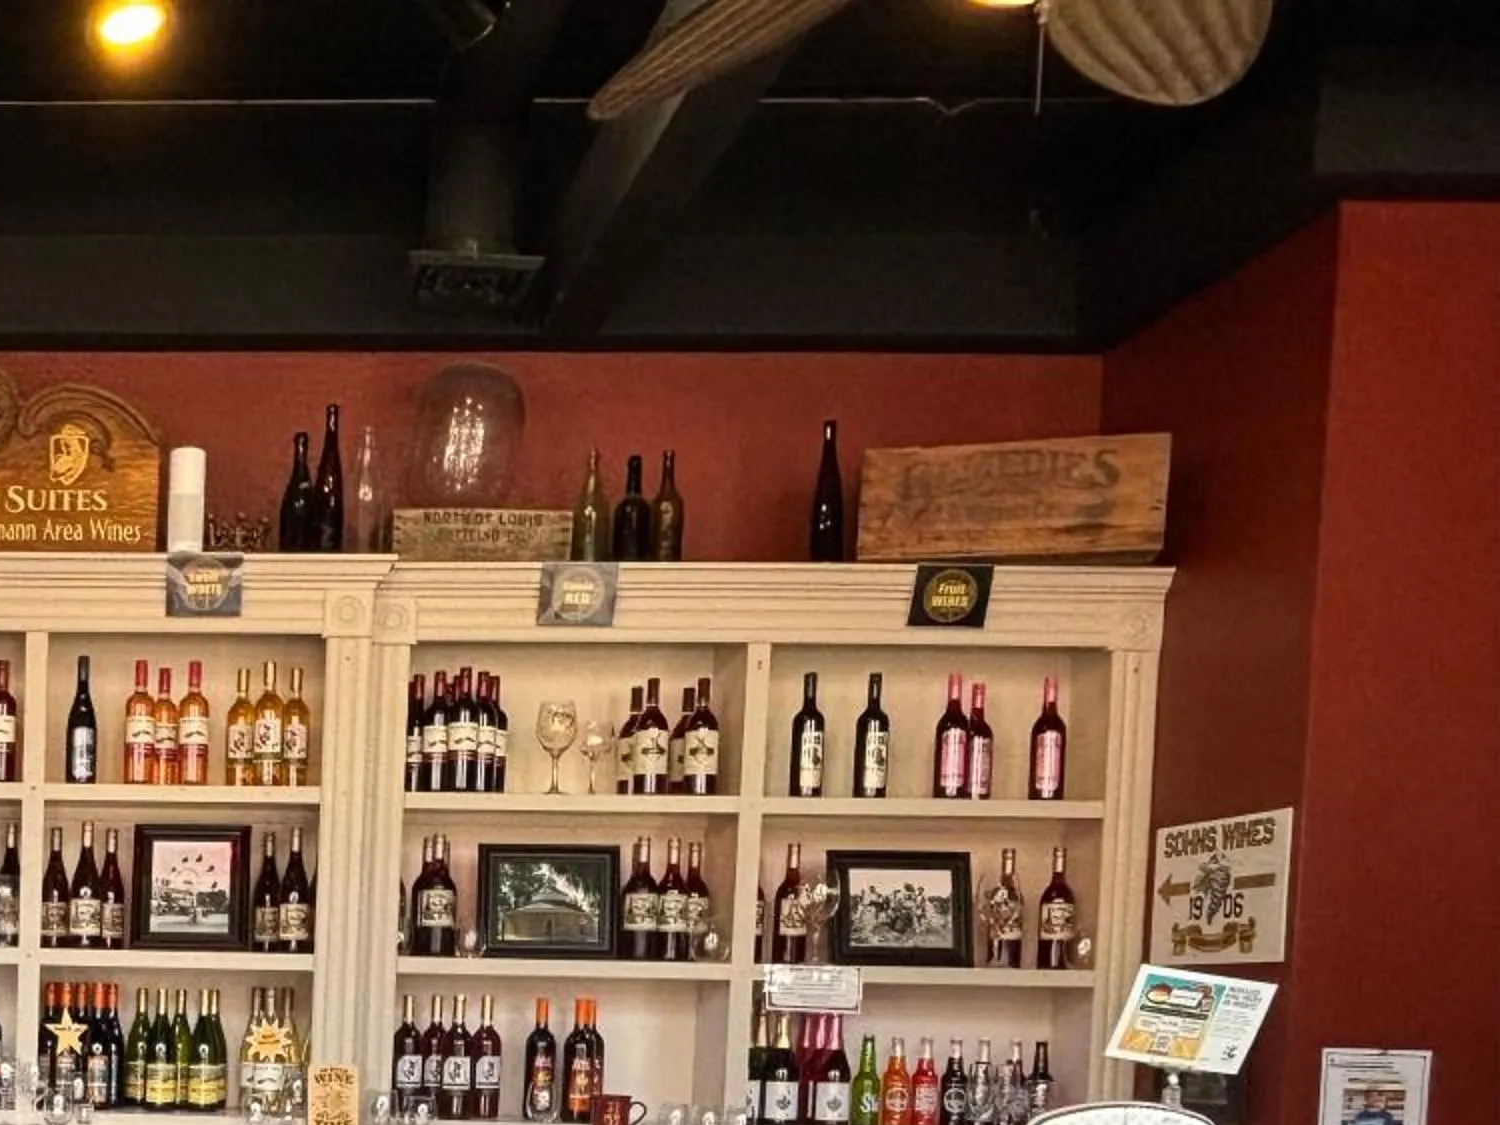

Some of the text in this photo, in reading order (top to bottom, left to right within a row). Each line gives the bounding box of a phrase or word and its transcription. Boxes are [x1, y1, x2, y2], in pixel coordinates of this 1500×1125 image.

[5, 485, 107, 512] SUITES
[43, 518, 84, 541] Area
[90, 520, 140, 544] Wines
[1164, 817, 1277, 858] SOHNS WINES
[314, 1073, 353, 1085] WINE
